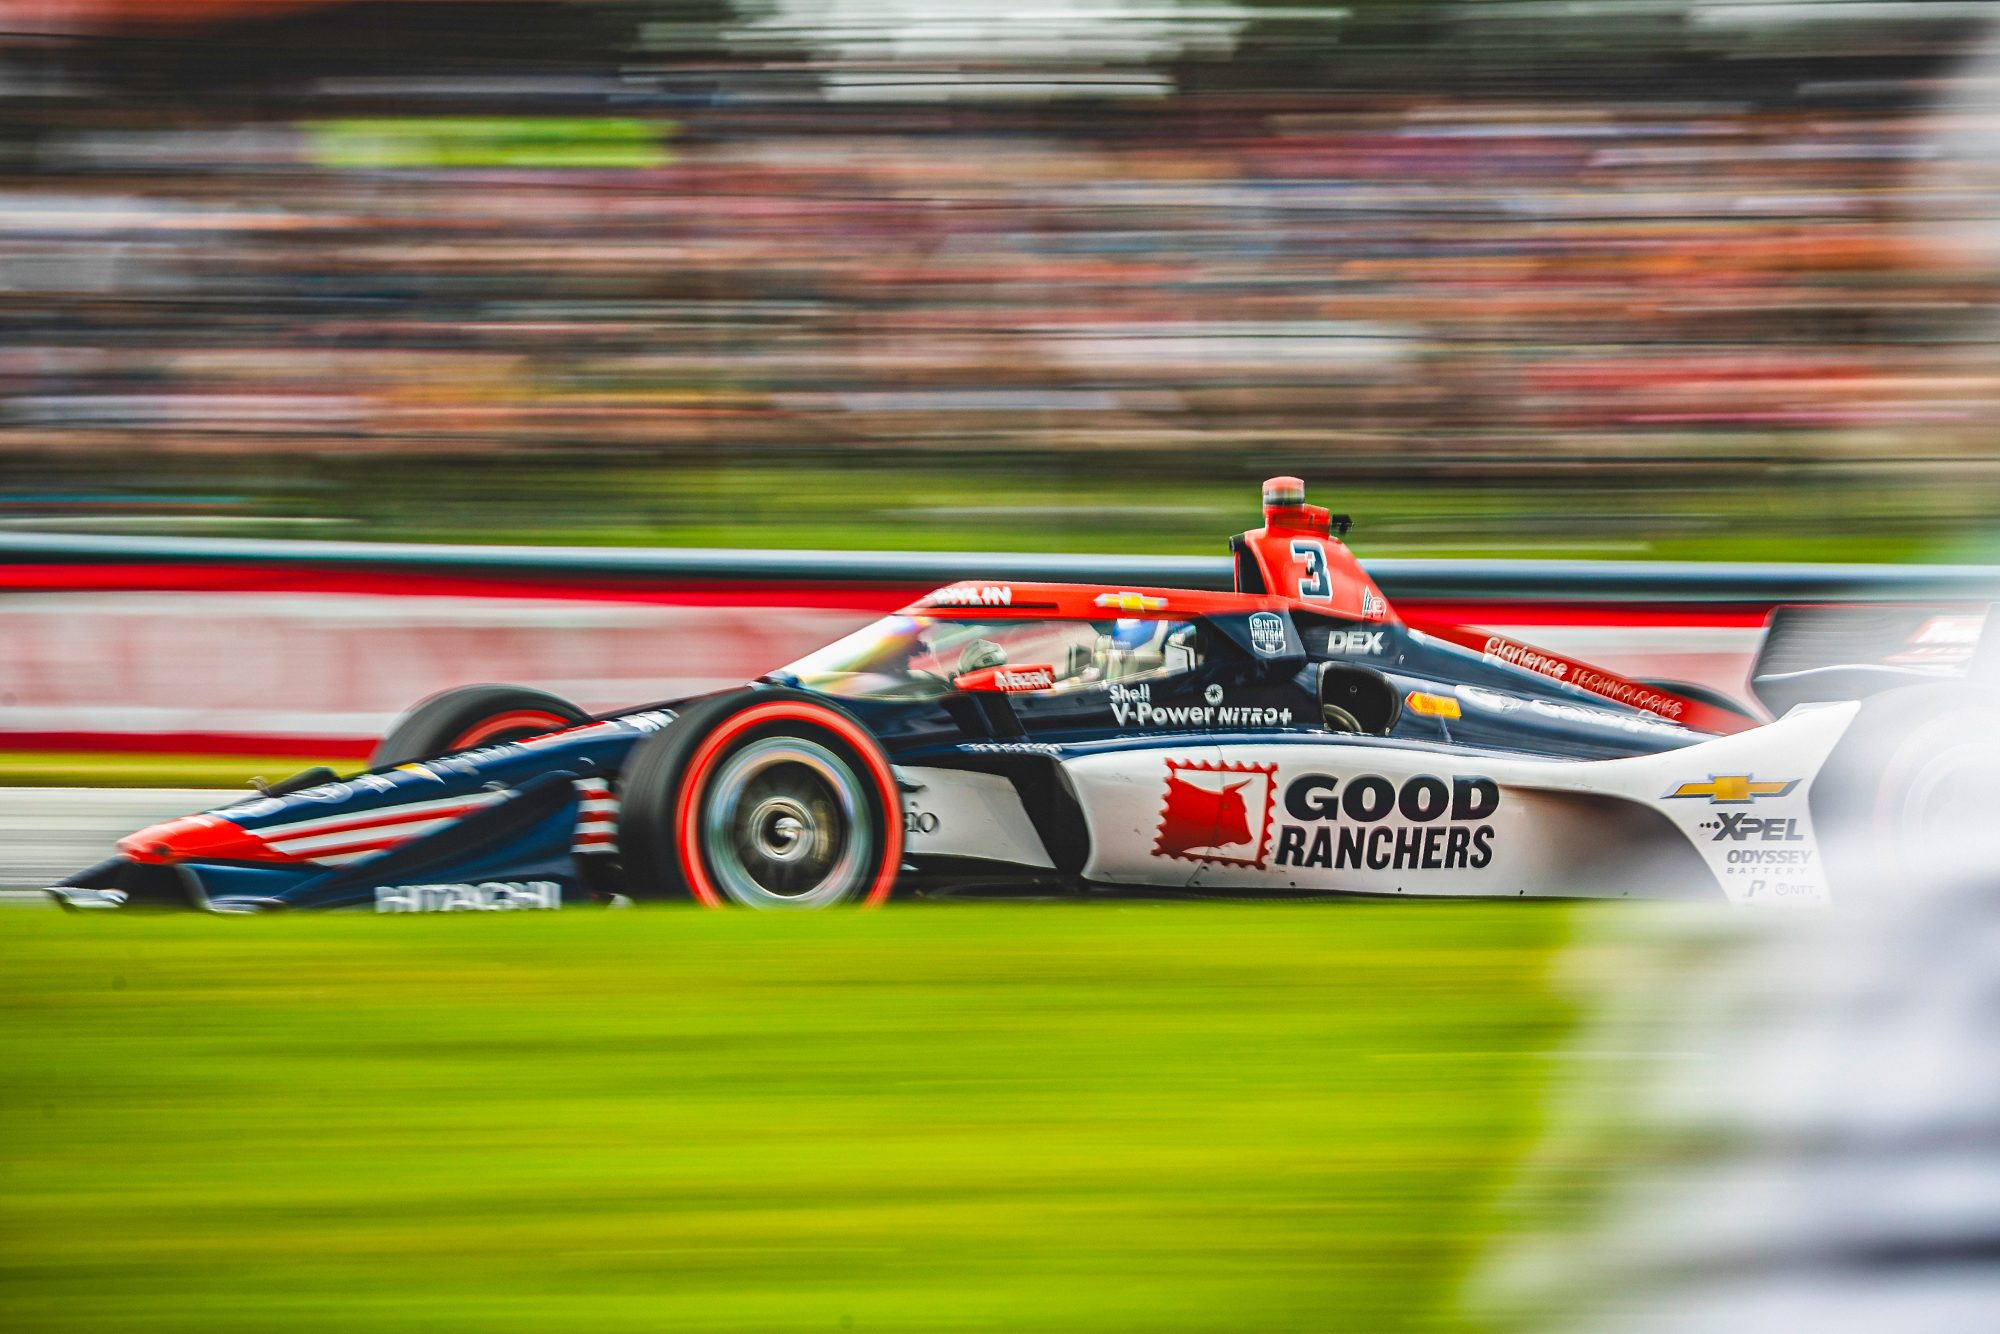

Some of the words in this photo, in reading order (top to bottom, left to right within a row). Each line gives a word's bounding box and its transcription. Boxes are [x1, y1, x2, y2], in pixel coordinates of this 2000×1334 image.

[1290, 540, 1333, 602] 3
[1262, 619, 1280, 630] NTT
[1327, 631, 1385, 655] DEX
[1484, 636, 1568, 679] Clarience
[1570, 667, 1683, 718] TECHNOLOGIES
[1109, 684, 1150, 702] Shell
[1110, 702, 1216, 726] V-Power
[1284, 773, 1500, 822] GOOD
[1712, 813, 1804, 841] XPEL
[1274, 824, 1496, 869] RANCHERS
[1726, 849, 1813, 864] ODYSSEY
[1726, 867, 1808, 875] BATTERY
[375, 881, 563, 912] HITACHI
